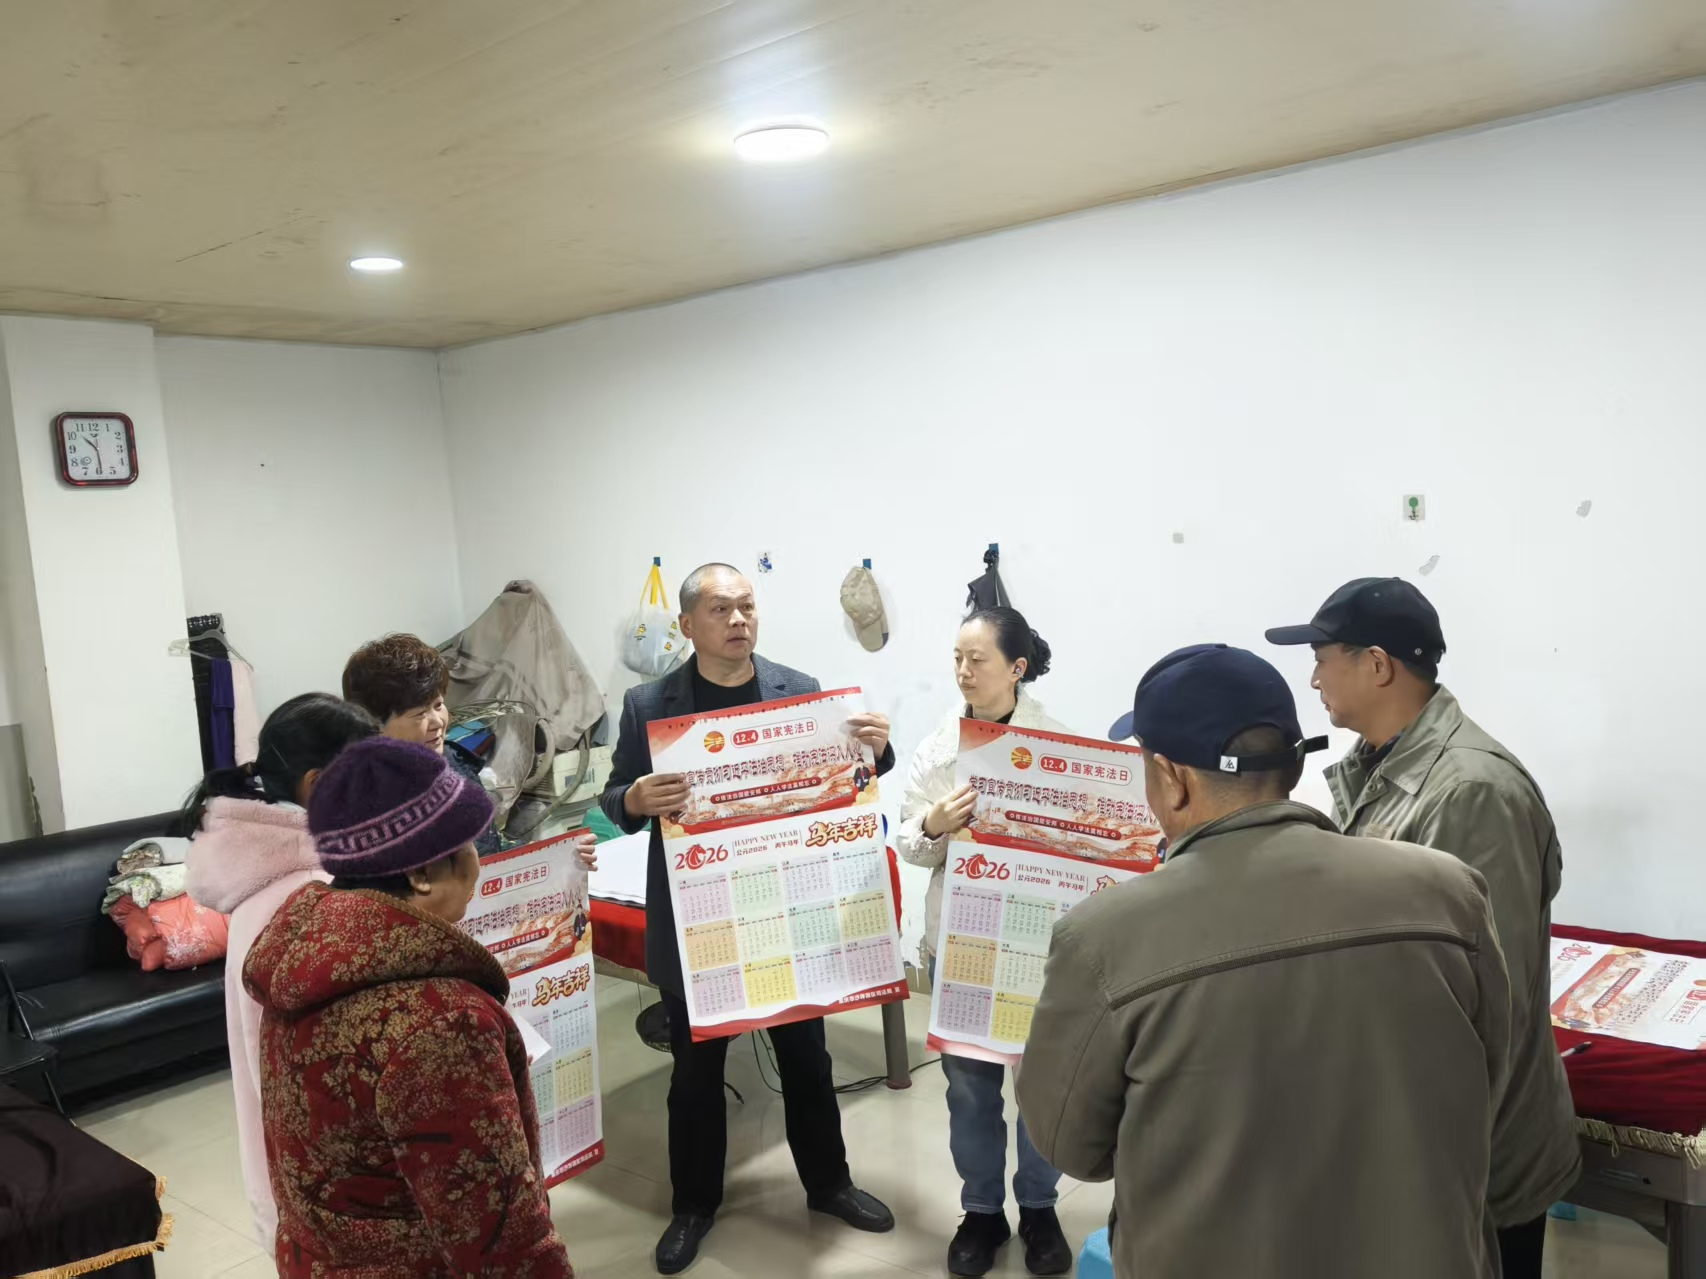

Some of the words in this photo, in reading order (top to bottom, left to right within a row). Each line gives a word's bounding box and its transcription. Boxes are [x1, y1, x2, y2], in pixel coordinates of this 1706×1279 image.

[88, 423, 99, 431] 12
[68, 432, 76, 440] 10
[115, 432, 121, 440] 2
[69, 446, 76, 454] 9
[71, 458, 78, 466] 8
[82, 467, 88, 476] 7
[110, 467, 116, 475] 5
[735, 732, 757, 743] 12.4
[762, 724, 815, 740] 国家宪法日
[1043, 760, 1065, 770] 12.4
[1072, 762, 1128, 781] 国家宪法日
[806, 814, 878, 848] 马年吉祥
[735, 837, 758, 847] HAPPY
[761, 833, 777, 842] NEW
[779, 829, 798, 838] YEAR
[1018, 864, 1043, 874] HAPPY
[1045, 869, 1063, 877] NEW
[1065, 873, 1085, 881] YEAR
[482, 880, 501, 893] 12.4
[506, 867, 547, 887] 国家宪法日
[1018, 875, 1051, 885] 公元2026
[532, 964, 590, 1006] 马年吉祥
